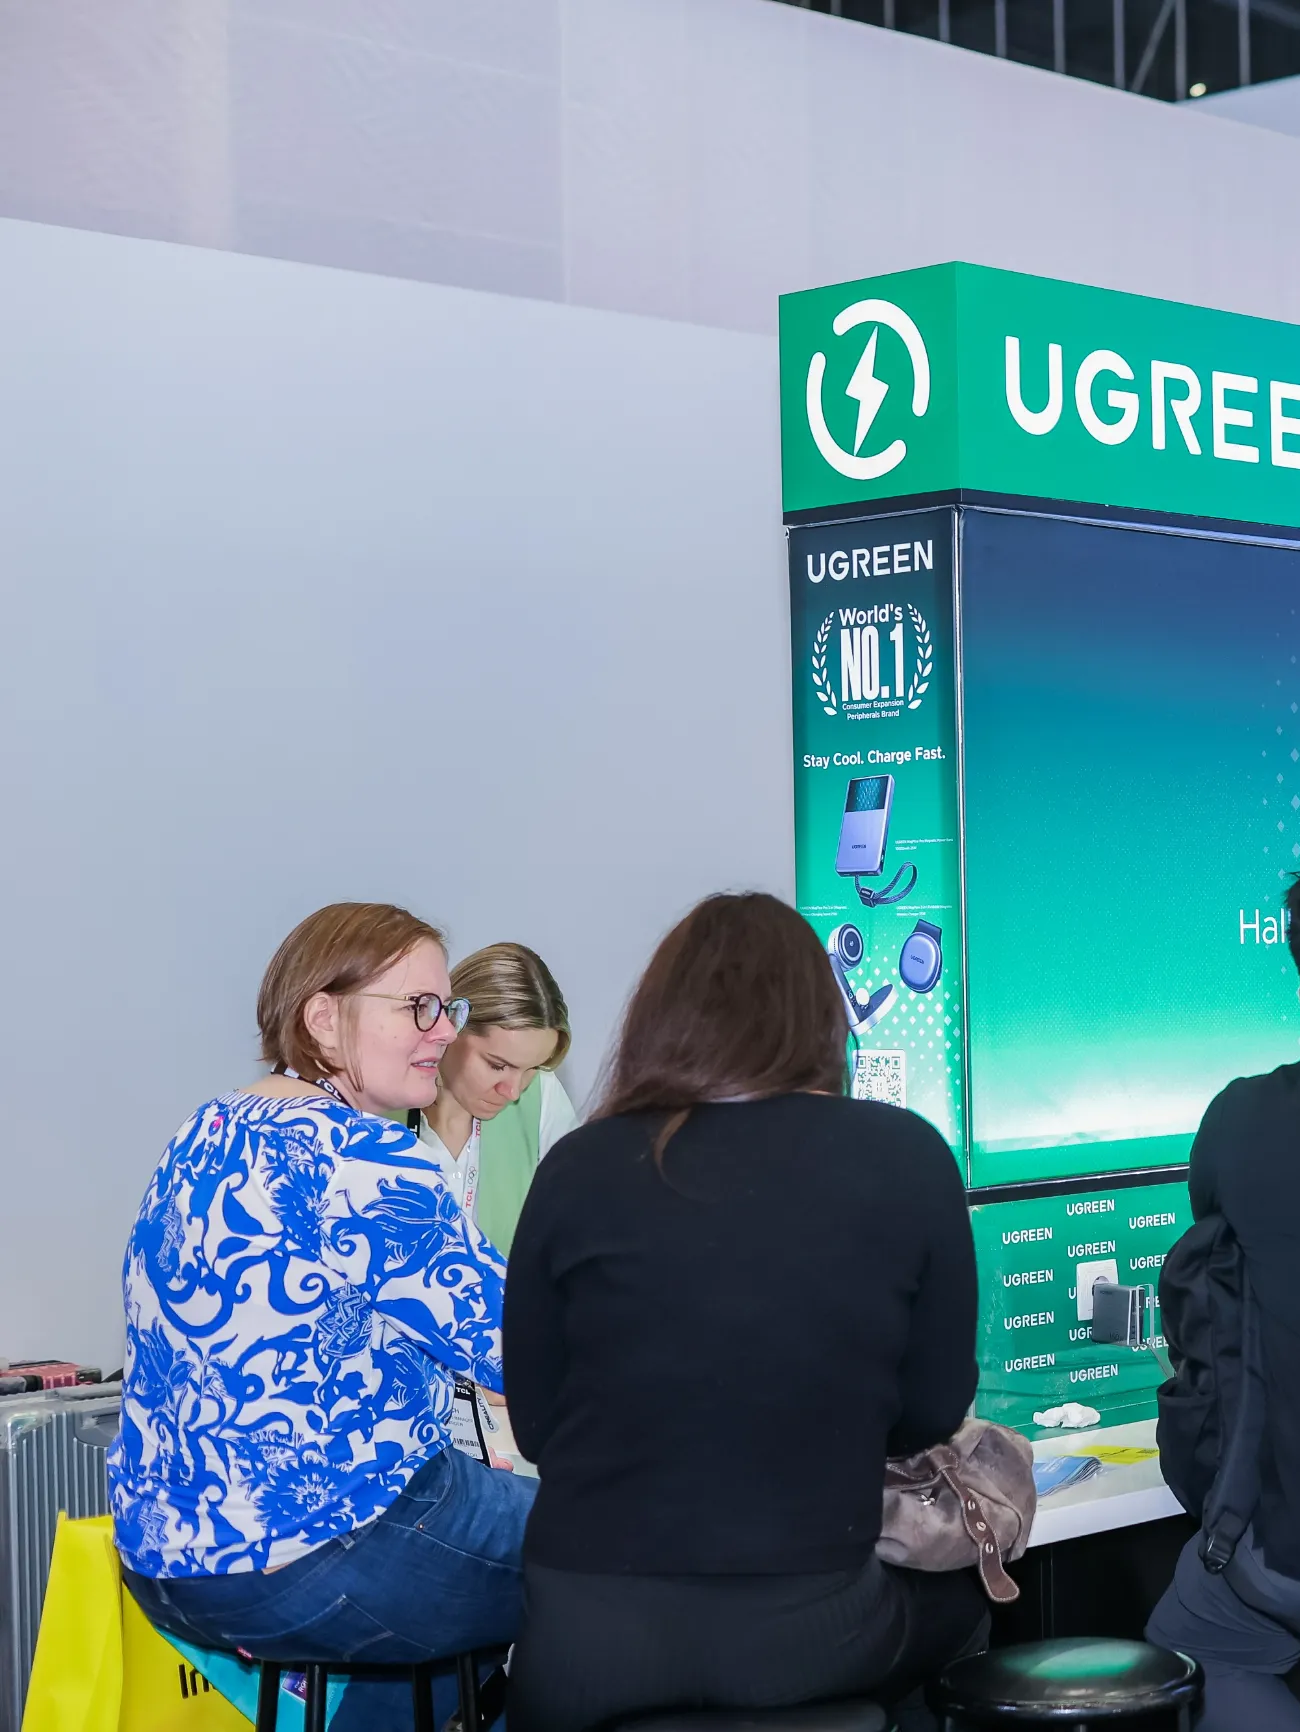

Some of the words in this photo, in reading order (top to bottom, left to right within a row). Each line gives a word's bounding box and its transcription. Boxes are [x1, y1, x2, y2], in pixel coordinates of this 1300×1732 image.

[807, 540, 933, 583] UGREEN
[838, 603, 904, 626] World's
[840, 623, 905, 702] NO.1
[842, 701, 872, 711] Consumer
[873, 699, 904, 710] Expansion
[847, 711, 880, 720] Peripherals
[881, 709, 899, 718] Brand
[803, 754, 830, 769] Stay
[833, 751, 864, 766] Cool.
[867, 748, 912, 765] Charge
[915, 746, 946, 760] Fast.
[1067, 1199, 1115, 1216] UGREEN
[1129, 1212, 1176, 1229] UGREEN
[1002, 1227, 1053, 1245] UGREEN
[1067, 1240, 1116, 1258] UGREEN
[1003, 1268, 1054, 1288] UGREEN
[1004, 1310, 1055, 1330] UGREEN
[1069, 1326, 1092, 1341] UGR
[1005, 1353, 1055, 1373] UGREEN
[1070, 1363, 1119, 1383] UGREEN
[456, 1386, 471, 1395] TCL
